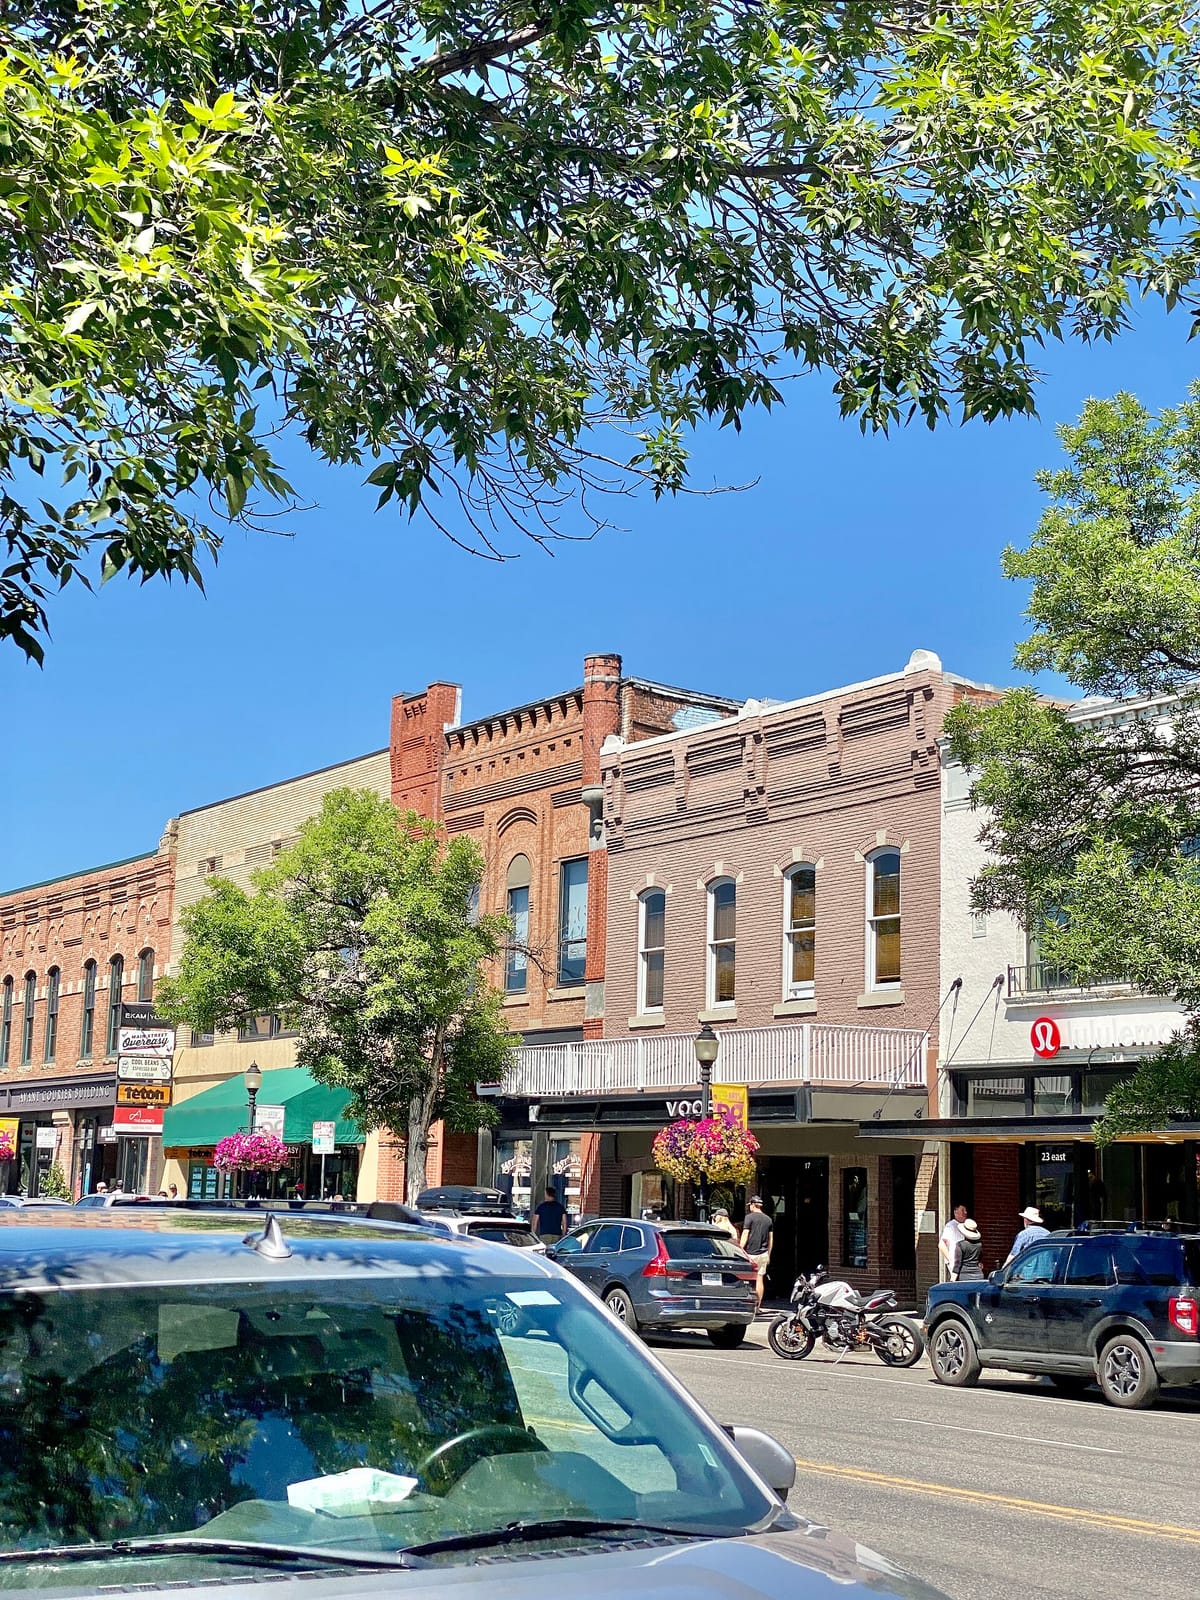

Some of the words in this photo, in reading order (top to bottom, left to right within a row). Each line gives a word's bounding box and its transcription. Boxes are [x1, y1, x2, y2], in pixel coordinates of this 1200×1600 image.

[1065, 1018, 1174, 1048] lululemo
[122, 1037, 169, 1048] Overeasy
[19, 1091, 41, 1103] AVANT
[41, 1088, 73, 1101] COURIER
[74, 1085, 110, 1099] BUILDING
[1041, 1152, 1050, 1161] 23
[1051, 1152, 1066, 1161] east
